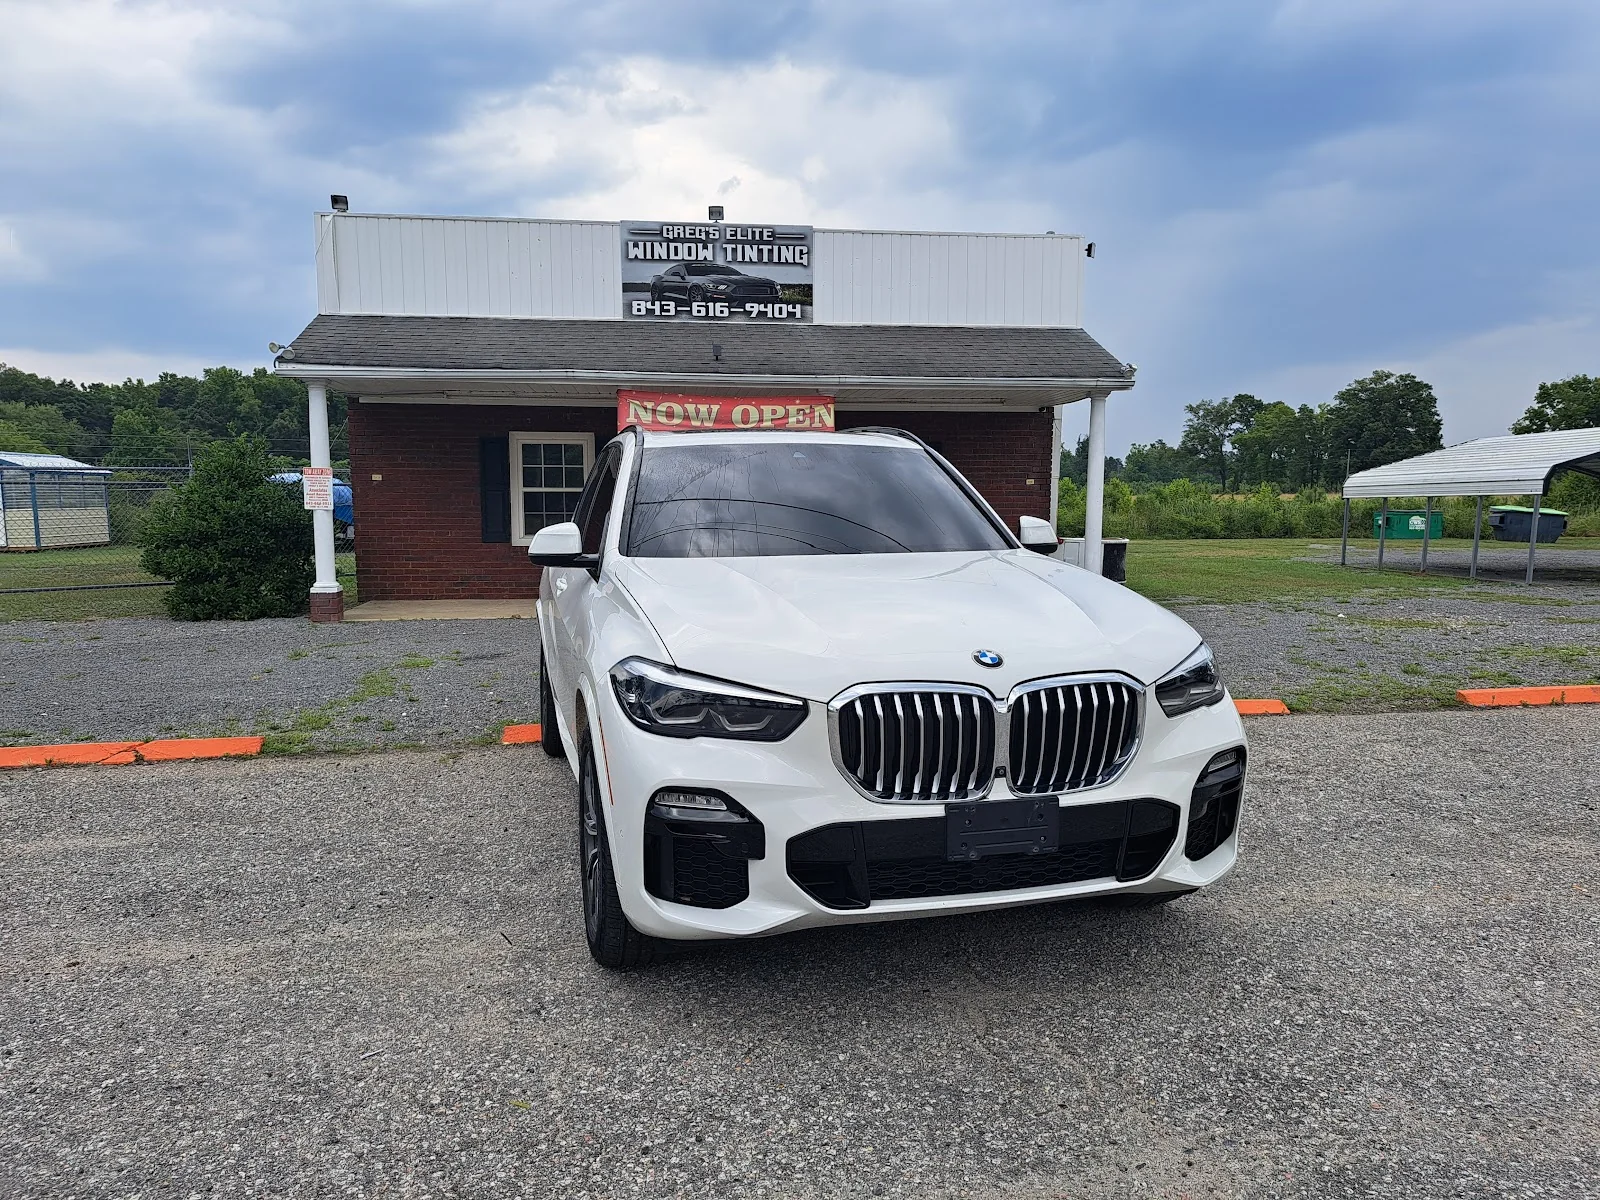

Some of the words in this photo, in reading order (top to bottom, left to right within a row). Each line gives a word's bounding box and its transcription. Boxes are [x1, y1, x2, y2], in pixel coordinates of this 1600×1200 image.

[662, 225, 720, 240] GREG'S
[725, 227, 774, 241] ELITE
[627, 241, 714, 261] WINDOW
[722, 243, 809, 267] TINTING
[631, 300, 802, 319] 843-616-9404
[626, 399, 720, 427] NOW
[731, 403, 835, 429] OPEN
